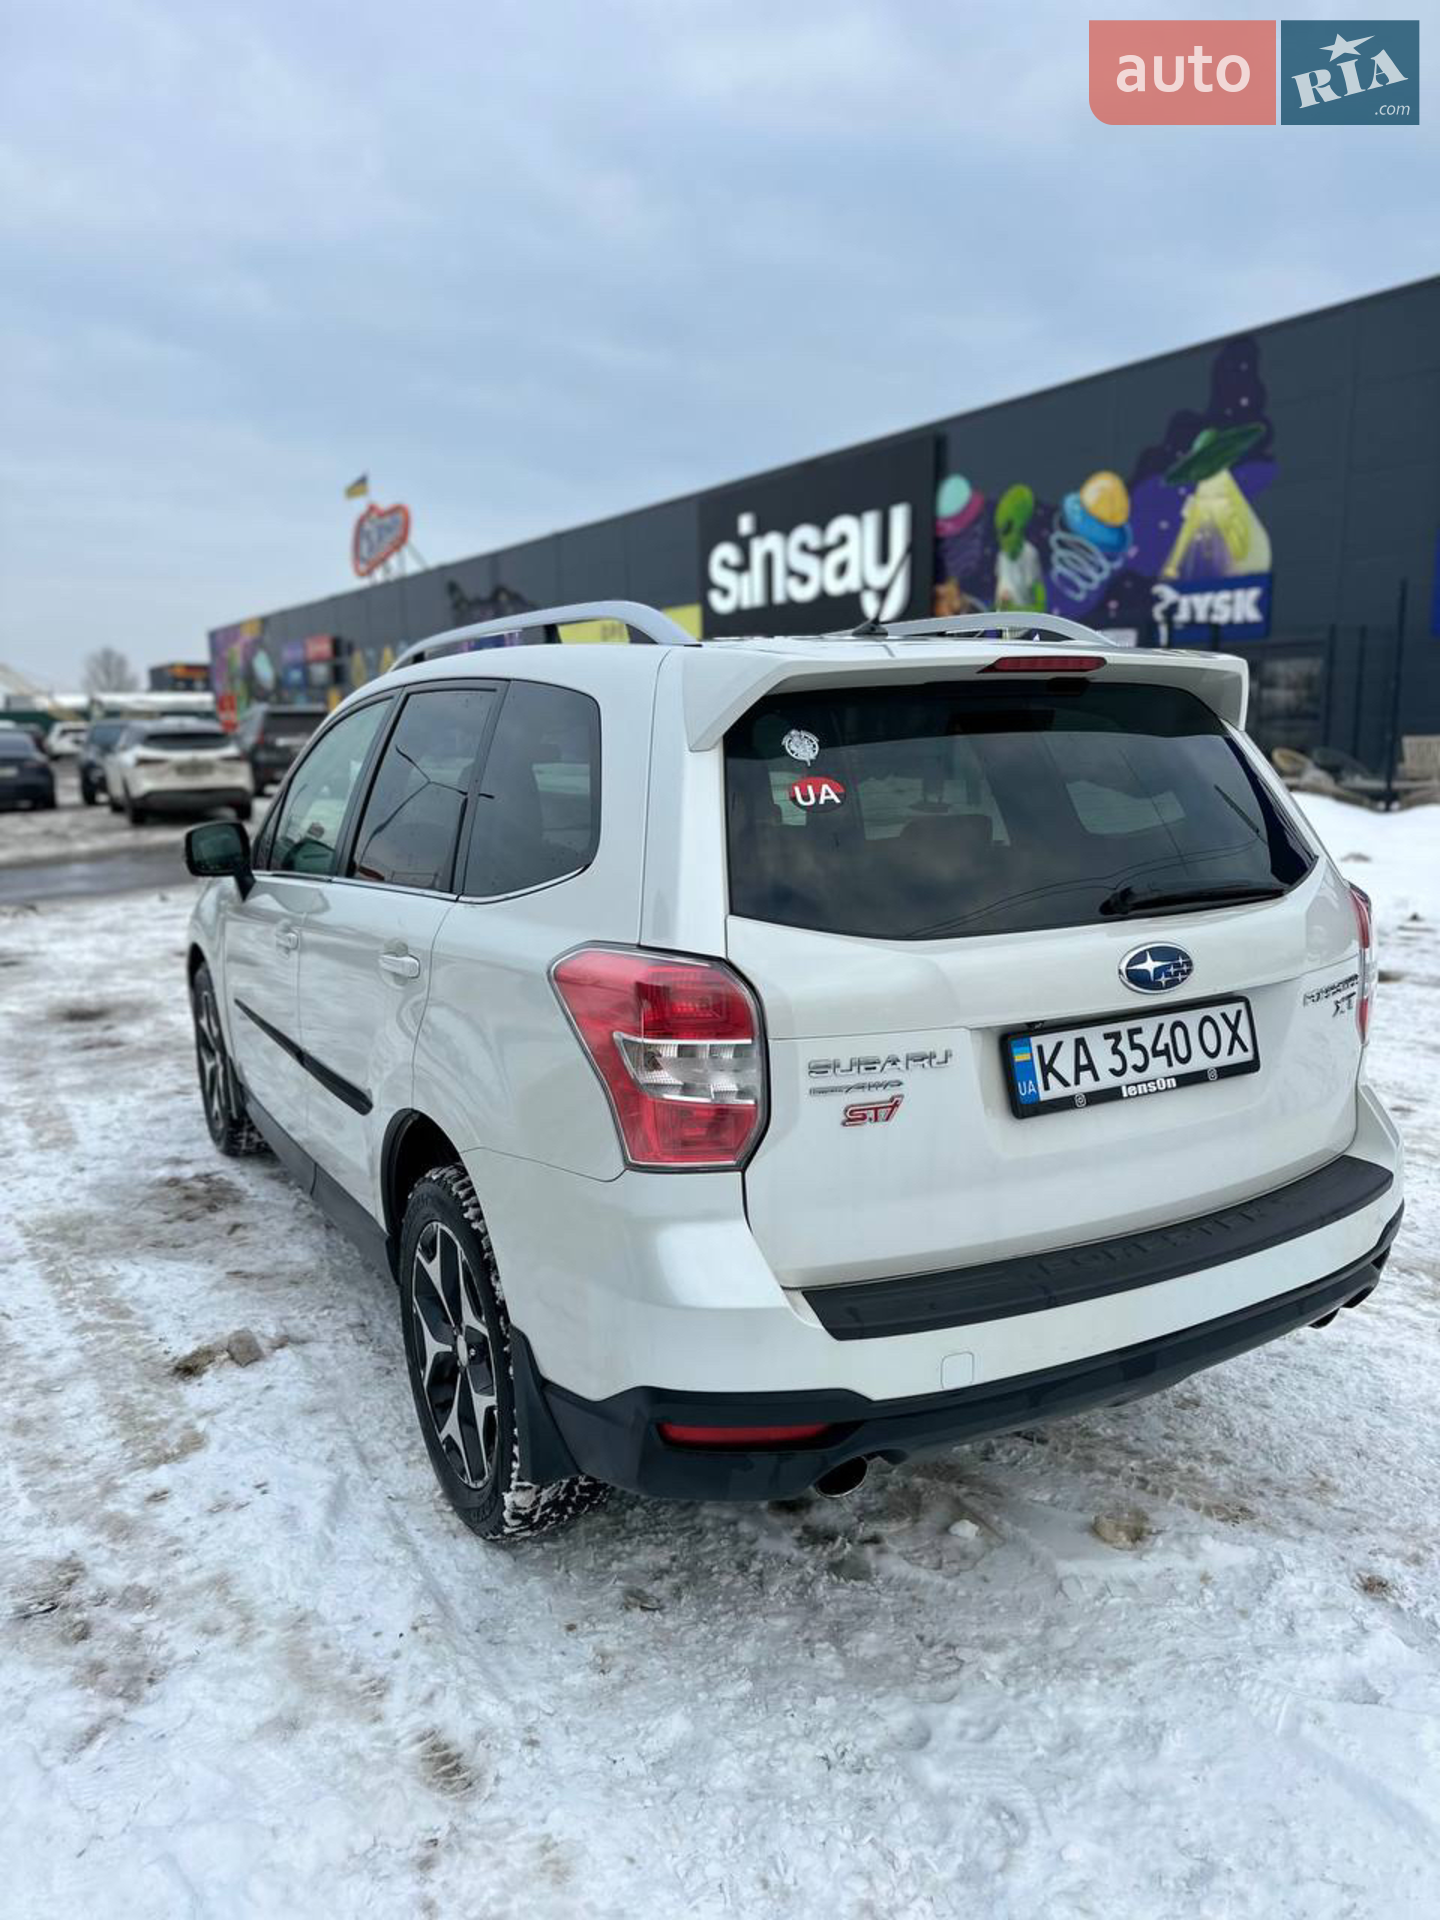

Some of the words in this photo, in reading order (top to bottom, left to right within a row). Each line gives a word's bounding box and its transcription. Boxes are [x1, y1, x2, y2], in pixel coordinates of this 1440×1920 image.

[708, 502, 912, 621] sinsay
[1173, 587, 1263, 625] JYSK
[794, 784, 841, 806] UA
[808, 1049, 954, 1078] SUBARU
[1036, 1036, 1100, 1091] KA
[1103, 1020, 1192, 1077] 3540
[1198, 1009, 1248, 1059] OX
[1018, 1080, 1037, 1096] UA
